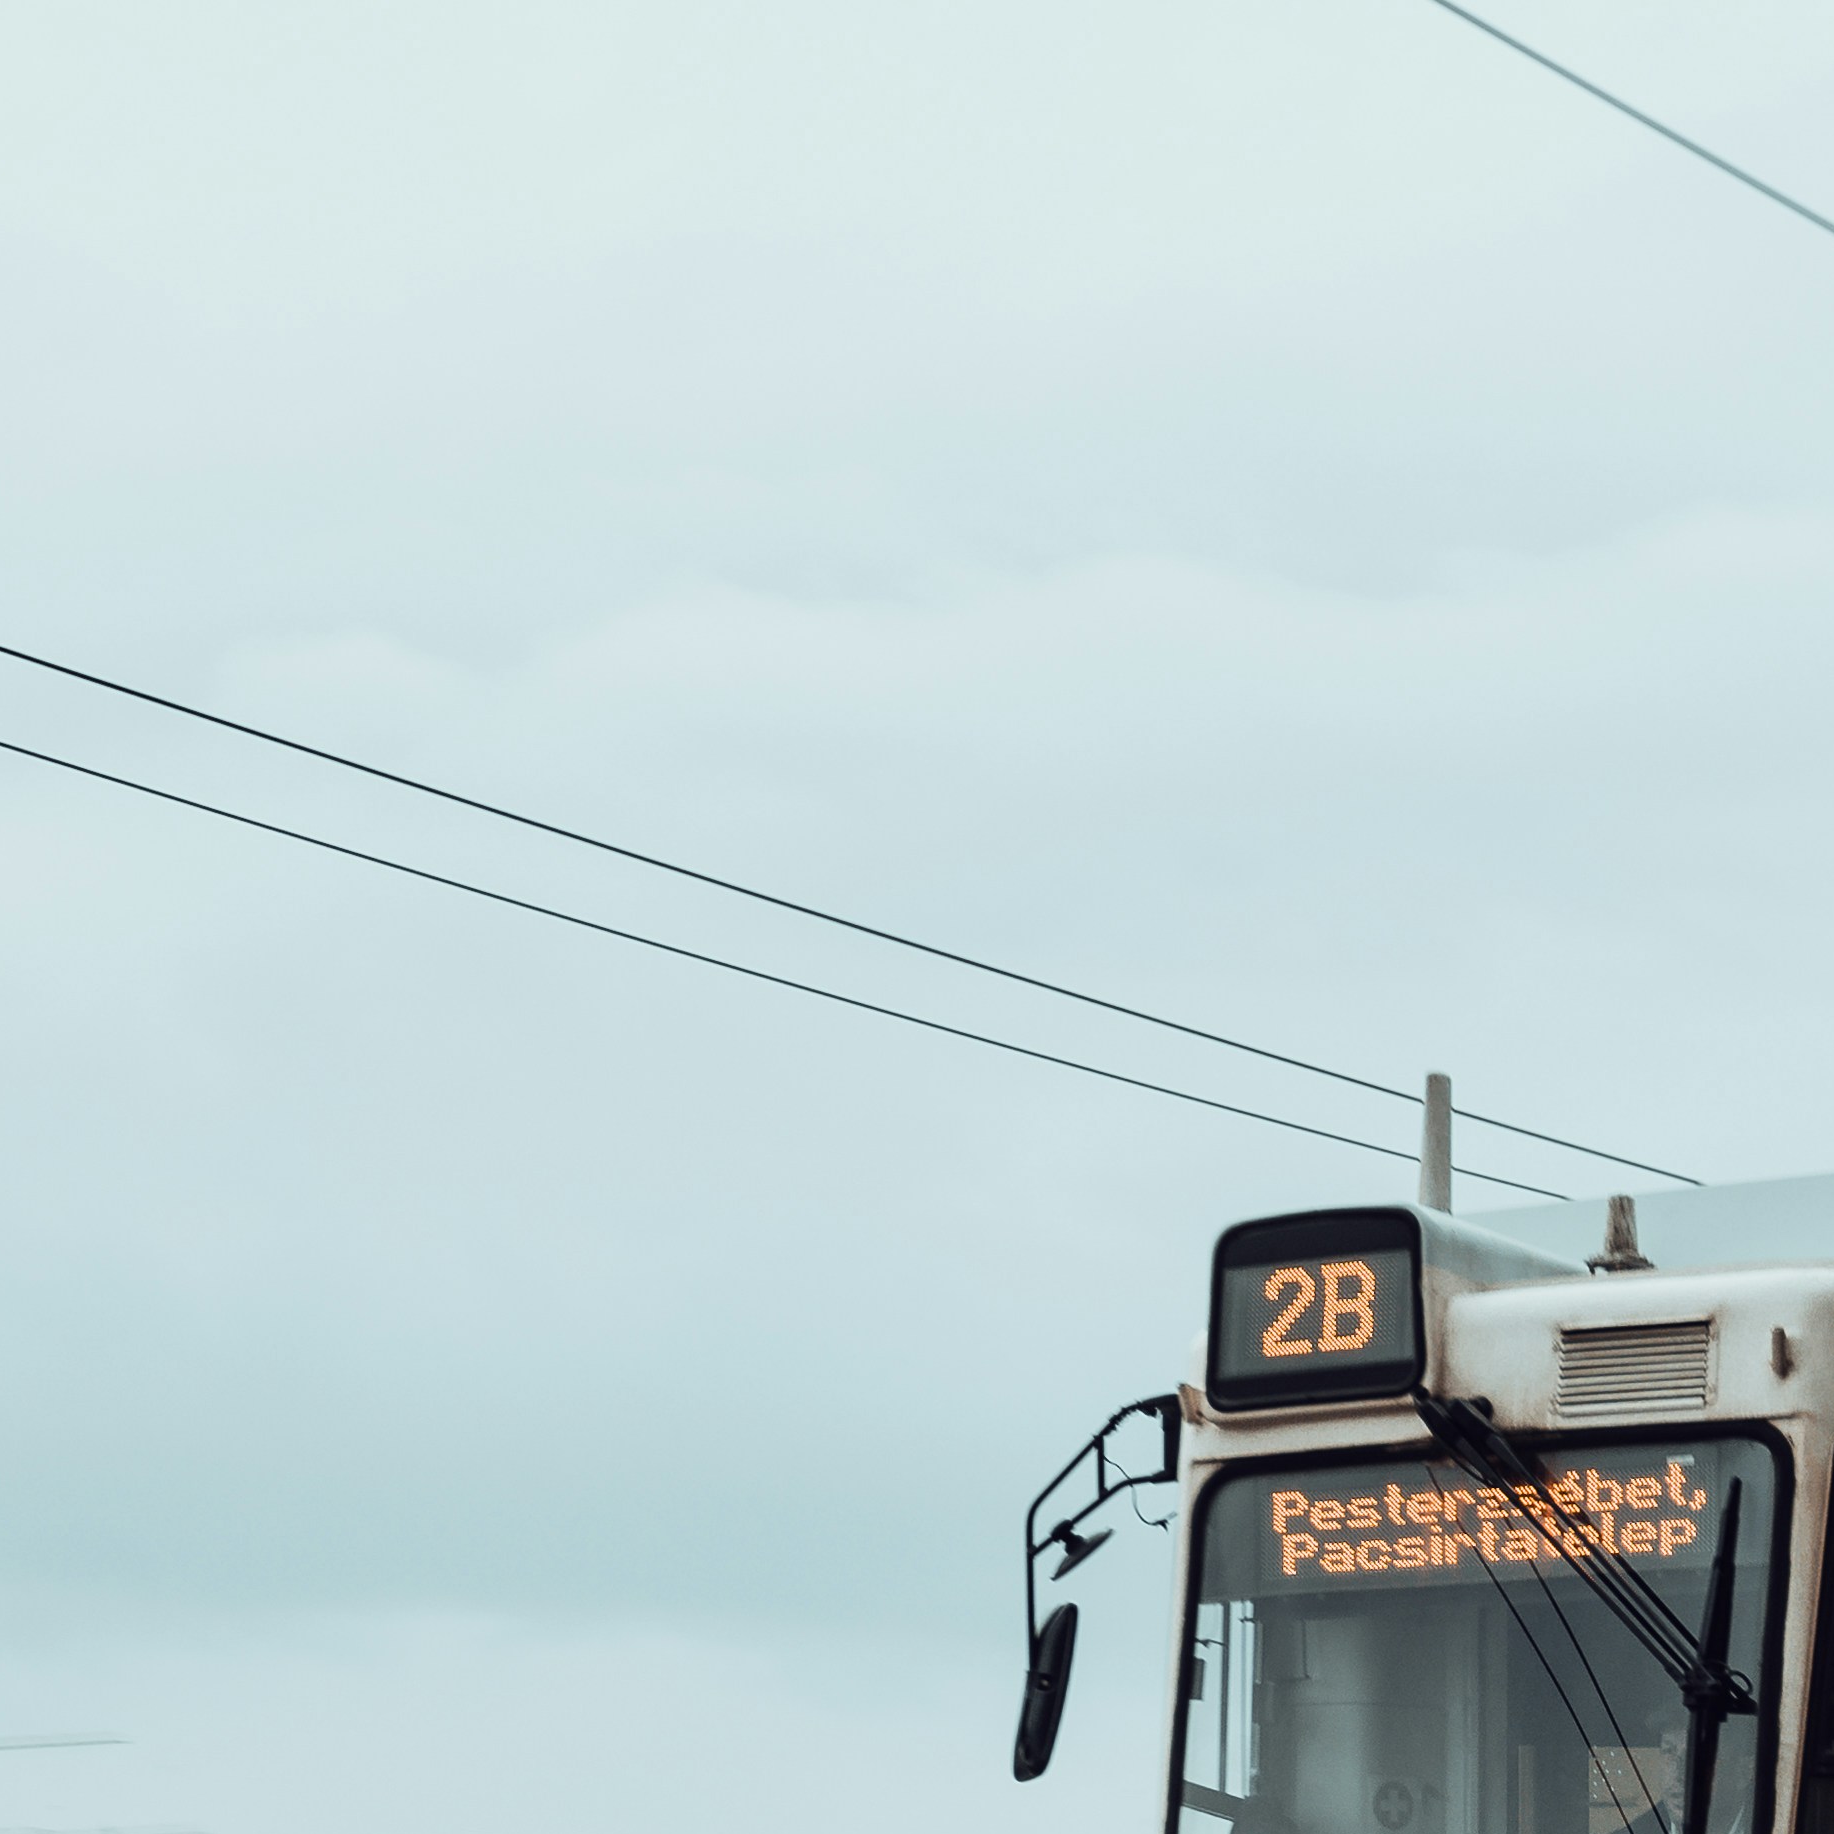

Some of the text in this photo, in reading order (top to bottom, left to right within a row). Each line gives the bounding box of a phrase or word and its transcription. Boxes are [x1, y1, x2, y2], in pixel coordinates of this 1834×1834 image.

[1263, 1261, 1375, 1357] 2B
[1272, 1462, 1708, 1534] Pesterzsébet,
[1282, 1512, 1698, 1576] Pacsirtatelep
